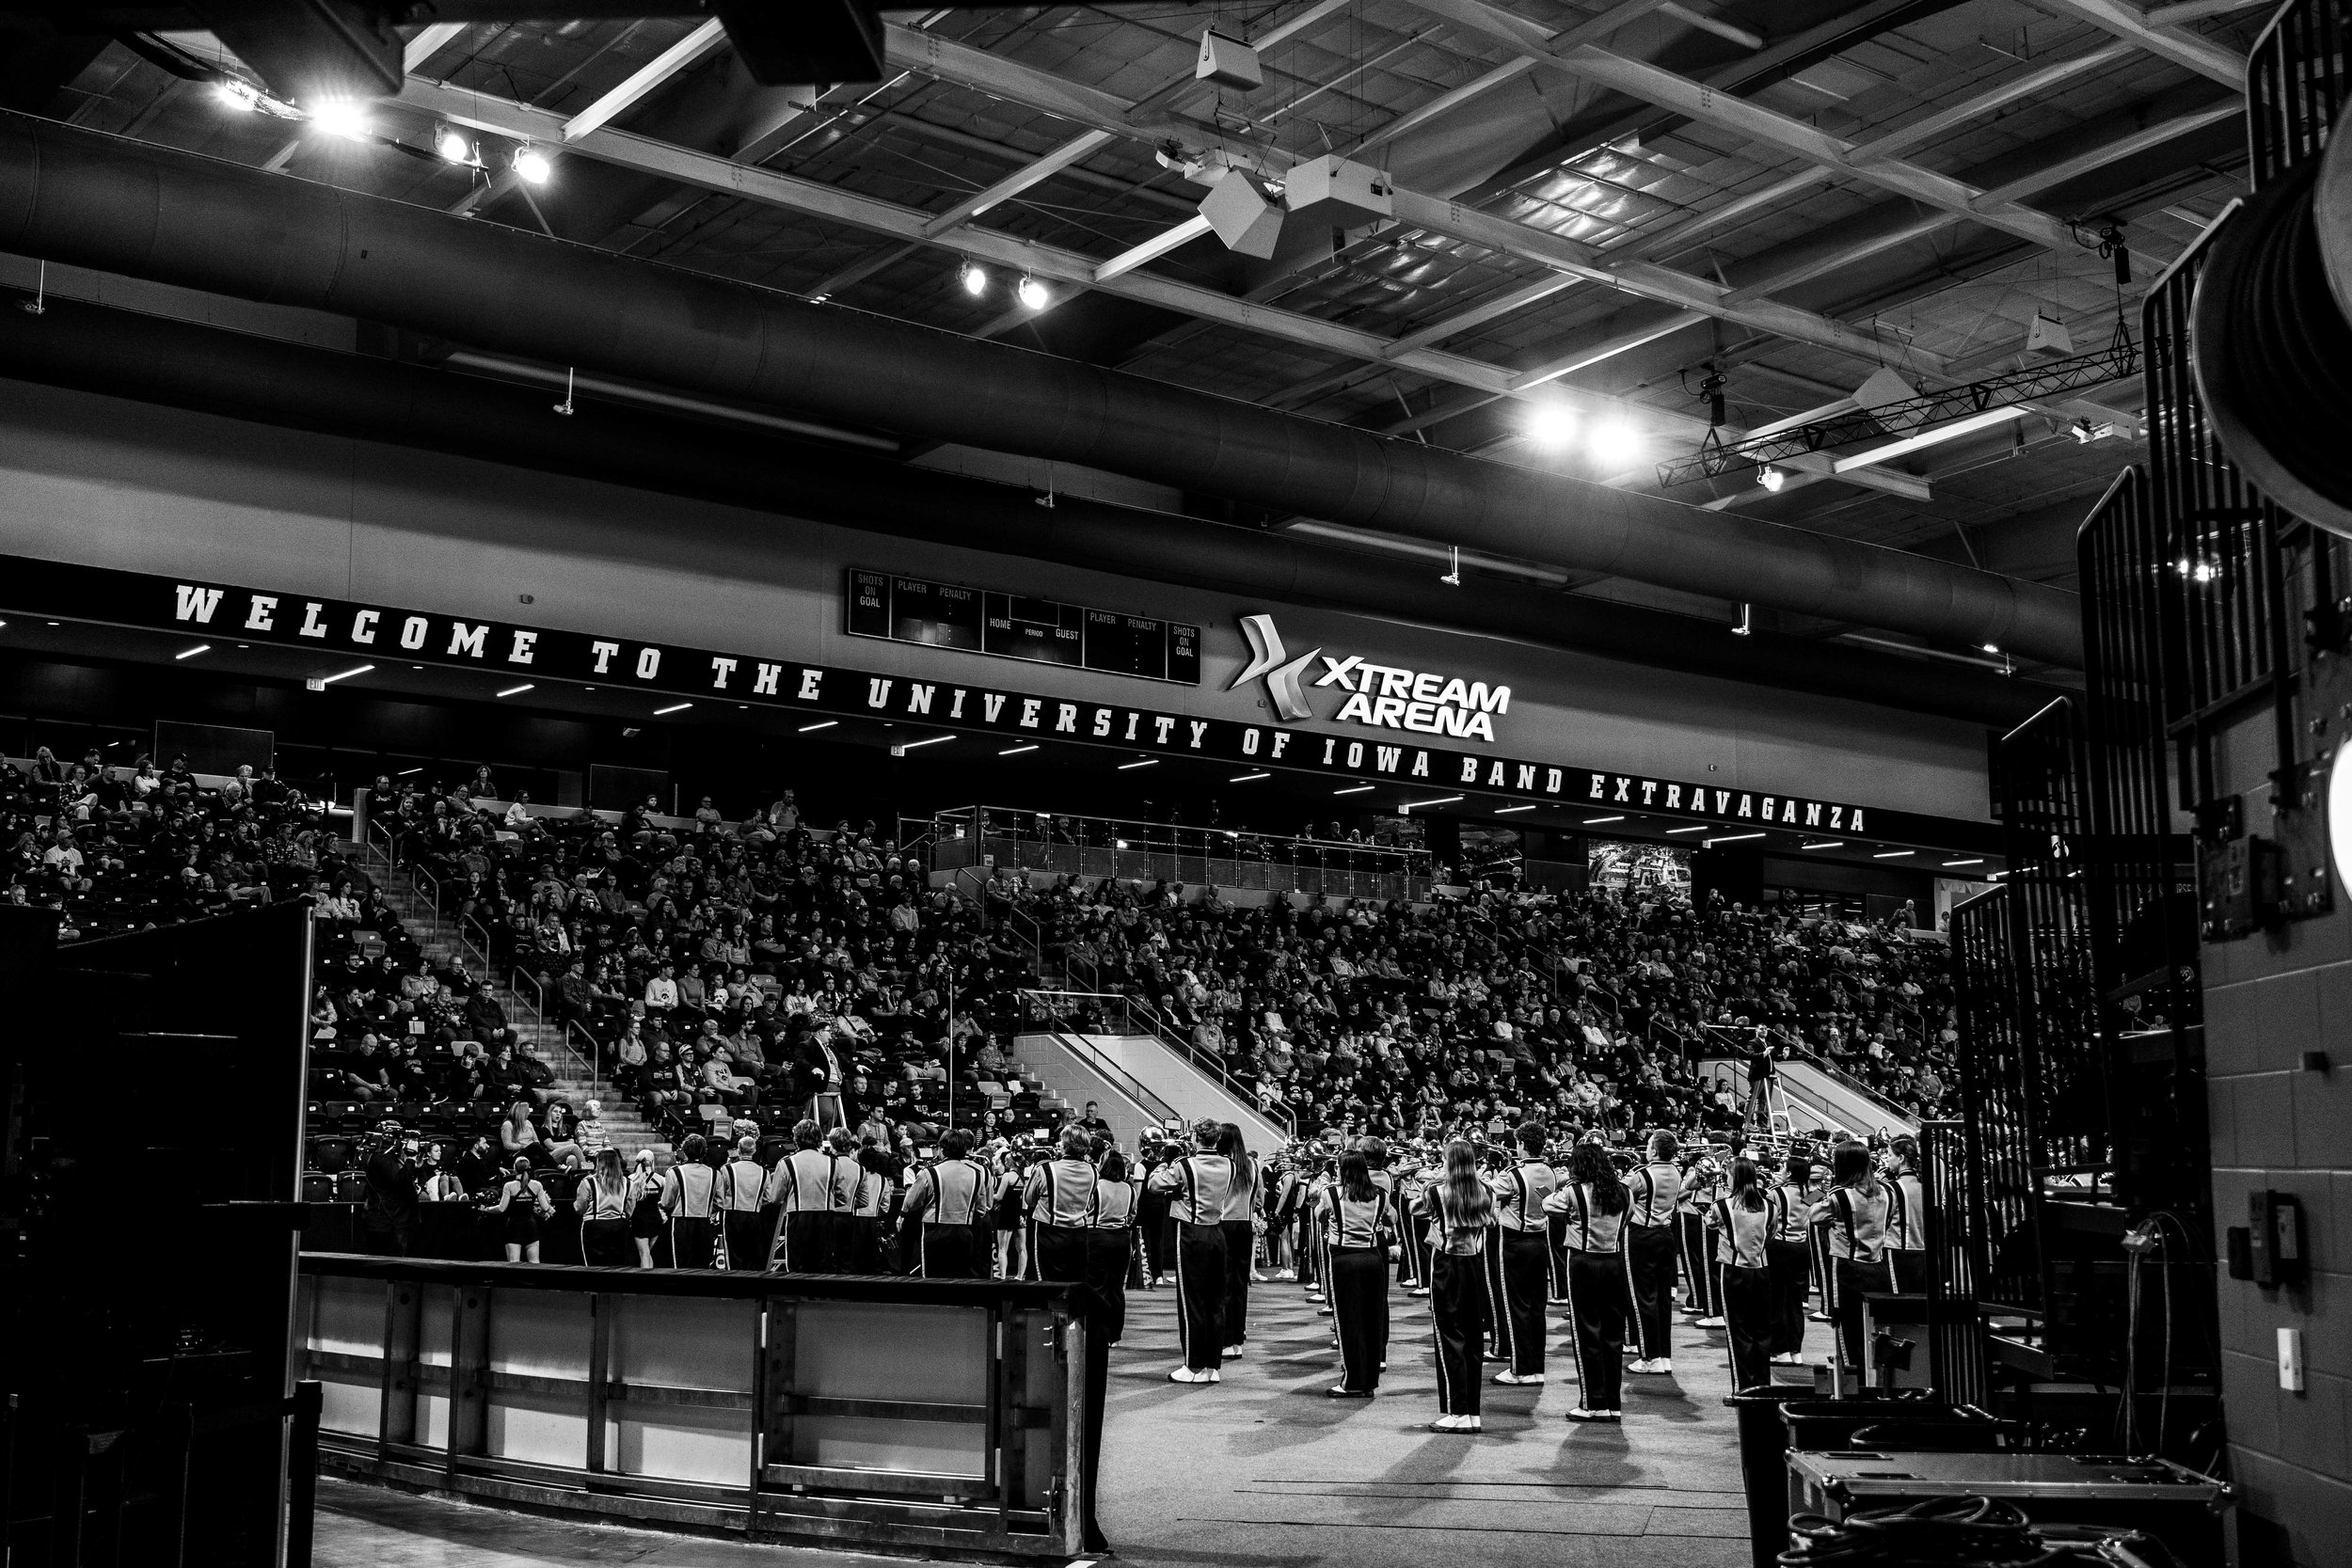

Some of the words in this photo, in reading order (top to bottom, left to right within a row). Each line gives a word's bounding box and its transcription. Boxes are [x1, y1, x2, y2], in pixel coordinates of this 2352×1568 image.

[858, 573, 883, 587] SHOTS
[865, 585, 876, 596] ON
[898, 580, 927, 594] PLAYER
[939, 587, 972, 601] PENALTY
[860, 595, 881, 608] GOAL
[990, 617, 1011, 629] HOME
[1090, 611, 1116, 625] PLAYER
[1127, 618, 1157, 631] PENALTY
[1025, 628, 1043, 638] PERIOD
[1056, 627, 1079, 641] GUEST
[1173, 626, 1195, 638] SHOTS
[1179, 637, 1189, 646] ON
[1176, 646, 1194, 657] GOAL
[310, 679, 323, 690] EXIT
[1314, 655, 1511, 715] XTREAM
[175, 584, 538, 664] WELCOME
[592, 641, 661, 680] TO
[711, 657, 823, 701] THE
[867, 677, 1208, 749] UNIVERSITY
[1242, 728, 1291, 759] OF
[1323, 738, 1429, 777] IOWA
[1460, 756, 1563, 794] BAND
[1589, 773, 1865, 832] EXTRAVAGANZA
[1336, 692, 1495, 742] ARENA
[1138, 1238, 1152, 1286] IOWA
